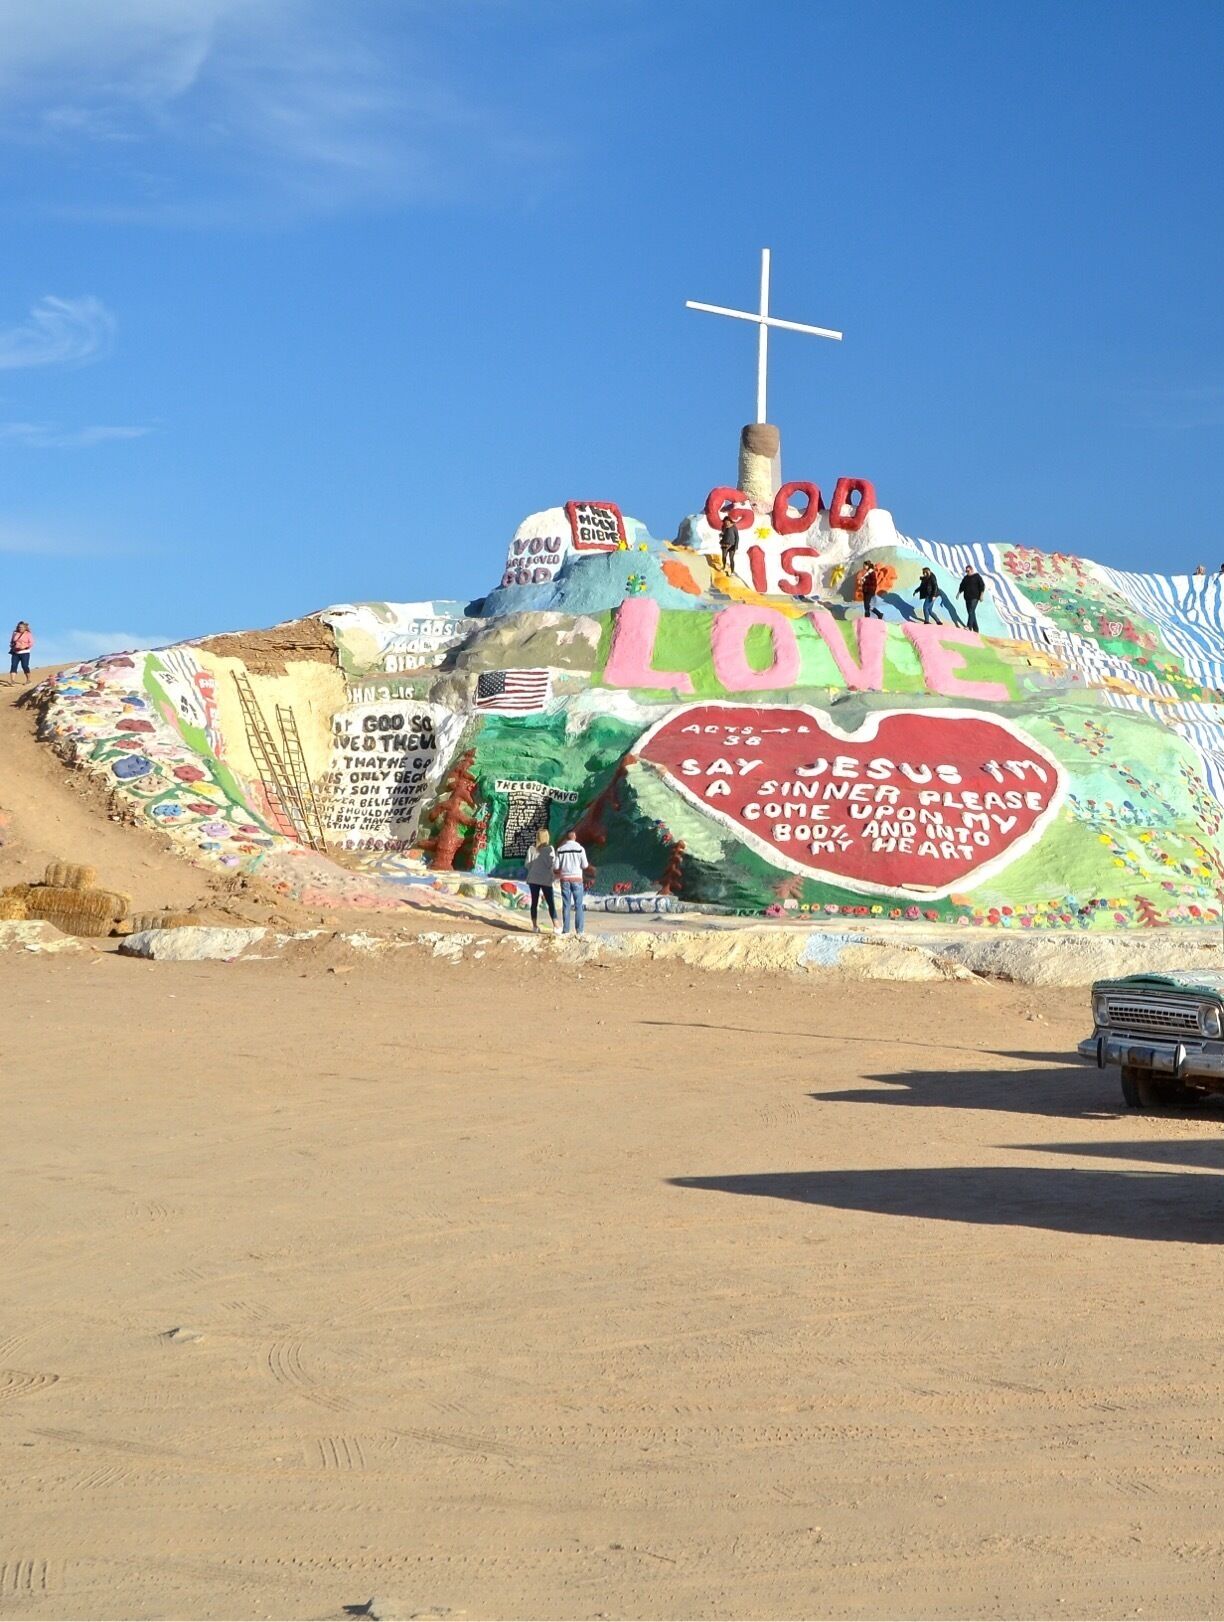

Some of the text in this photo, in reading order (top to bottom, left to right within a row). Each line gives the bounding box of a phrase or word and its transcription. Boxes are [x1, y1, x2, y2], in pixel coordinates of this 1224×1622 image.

[705, 477, 877, 535] GOD
[513, 537, 561, 555] YOU
[747, 545, 820, 596] IS
[603, 597, 1011, 701] LOVE
[350, 770, 390, 784] ONLY
[681, 758, 764, 776] SAY
[795, 756, 962, 784] JESUS
[351, 785, 380, 795] SON
[497, 781, 517, 790] THE
[549, 788, 578, 801] PRAYER
[705, 779, 1043, 811] A SINNER PLEASE
[742, 803, 1017, 834] COME UPON MY
[862, 820, 917, 838] AND
[926, 823, 990, 846] INTO
[810, 837, 974, 860] MY HEART
